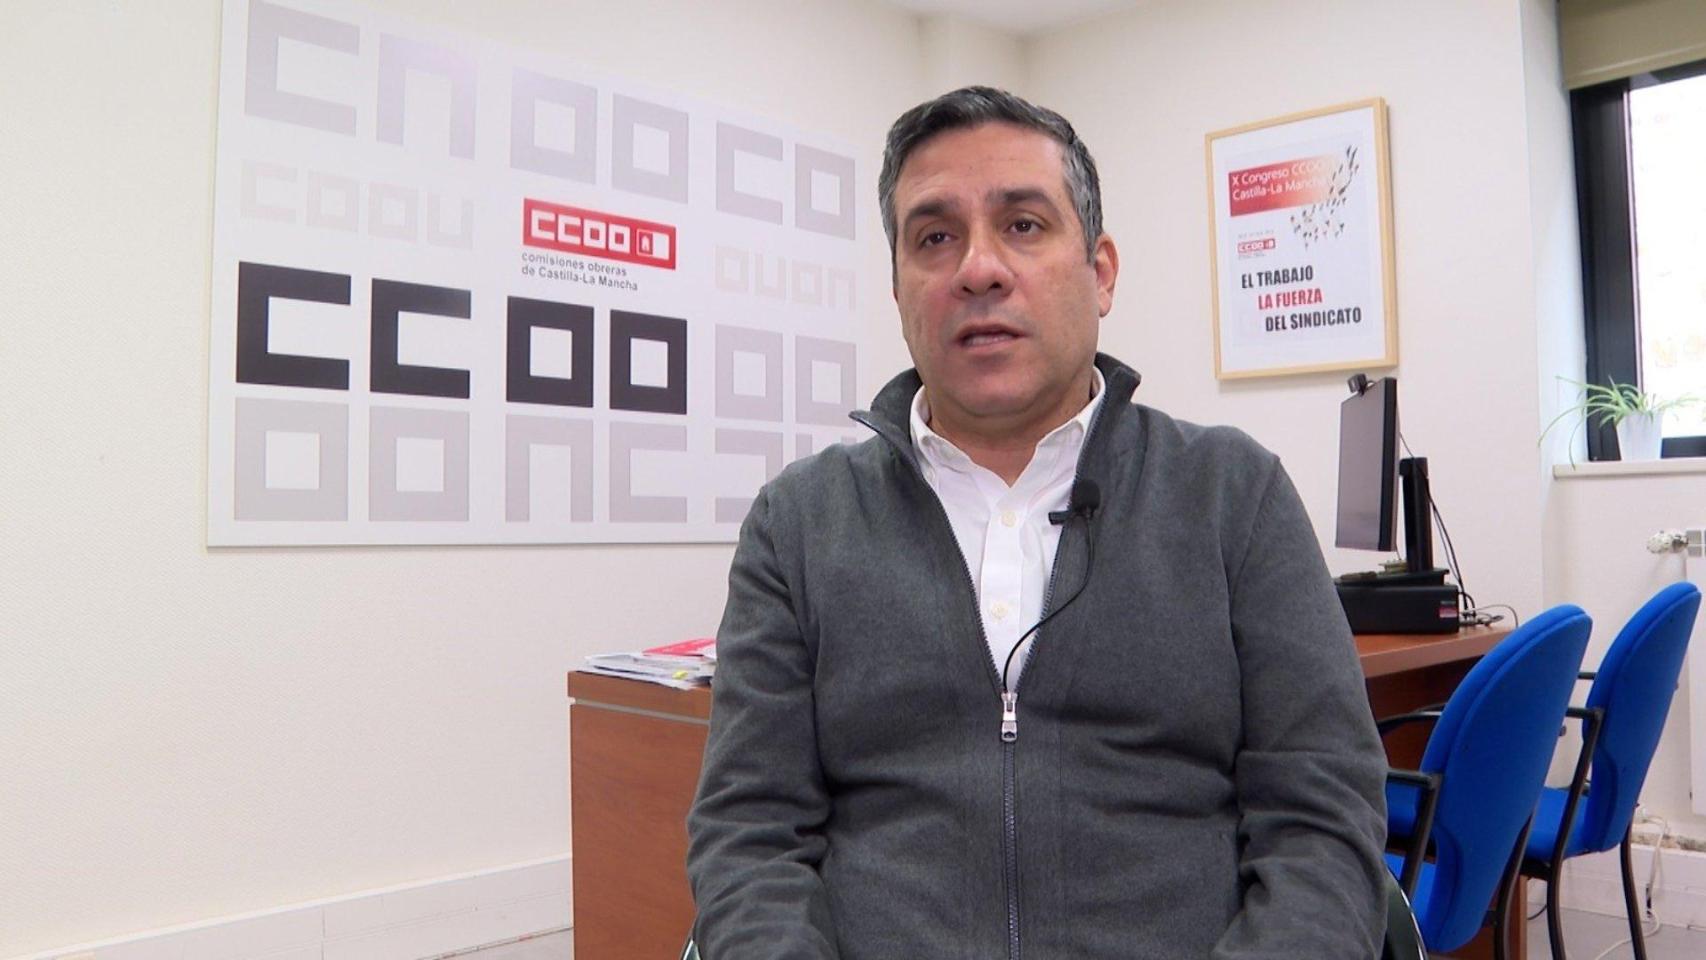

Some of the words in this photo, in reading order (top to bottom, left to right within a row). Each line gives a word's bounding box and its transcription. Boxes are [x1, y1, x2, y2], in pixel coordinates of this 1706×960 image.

[1231, 174, 1240, 187] X
[1241, 168, 1290, 186] Congreso
[531, 208, 631, 254] CCOO
[522, 252, 585, 271] comisiones
[588, 262, 627, 277] obreras
[1241, 273, 1254, 289] EL
[1257, 265, 1314, 287] TRABAJO
[521, 264, 536, 276] de
[538, 266, 596, 285] Castilla-La
[598, 276, 639, 292] Mancha
[1258, 294, 1273, 310] LA
[1275, 288, 1323, 308] FUERZA
[1265, 315, 1288, 332] DEL
[1290, 307, 1362, 330] SINDICATO
